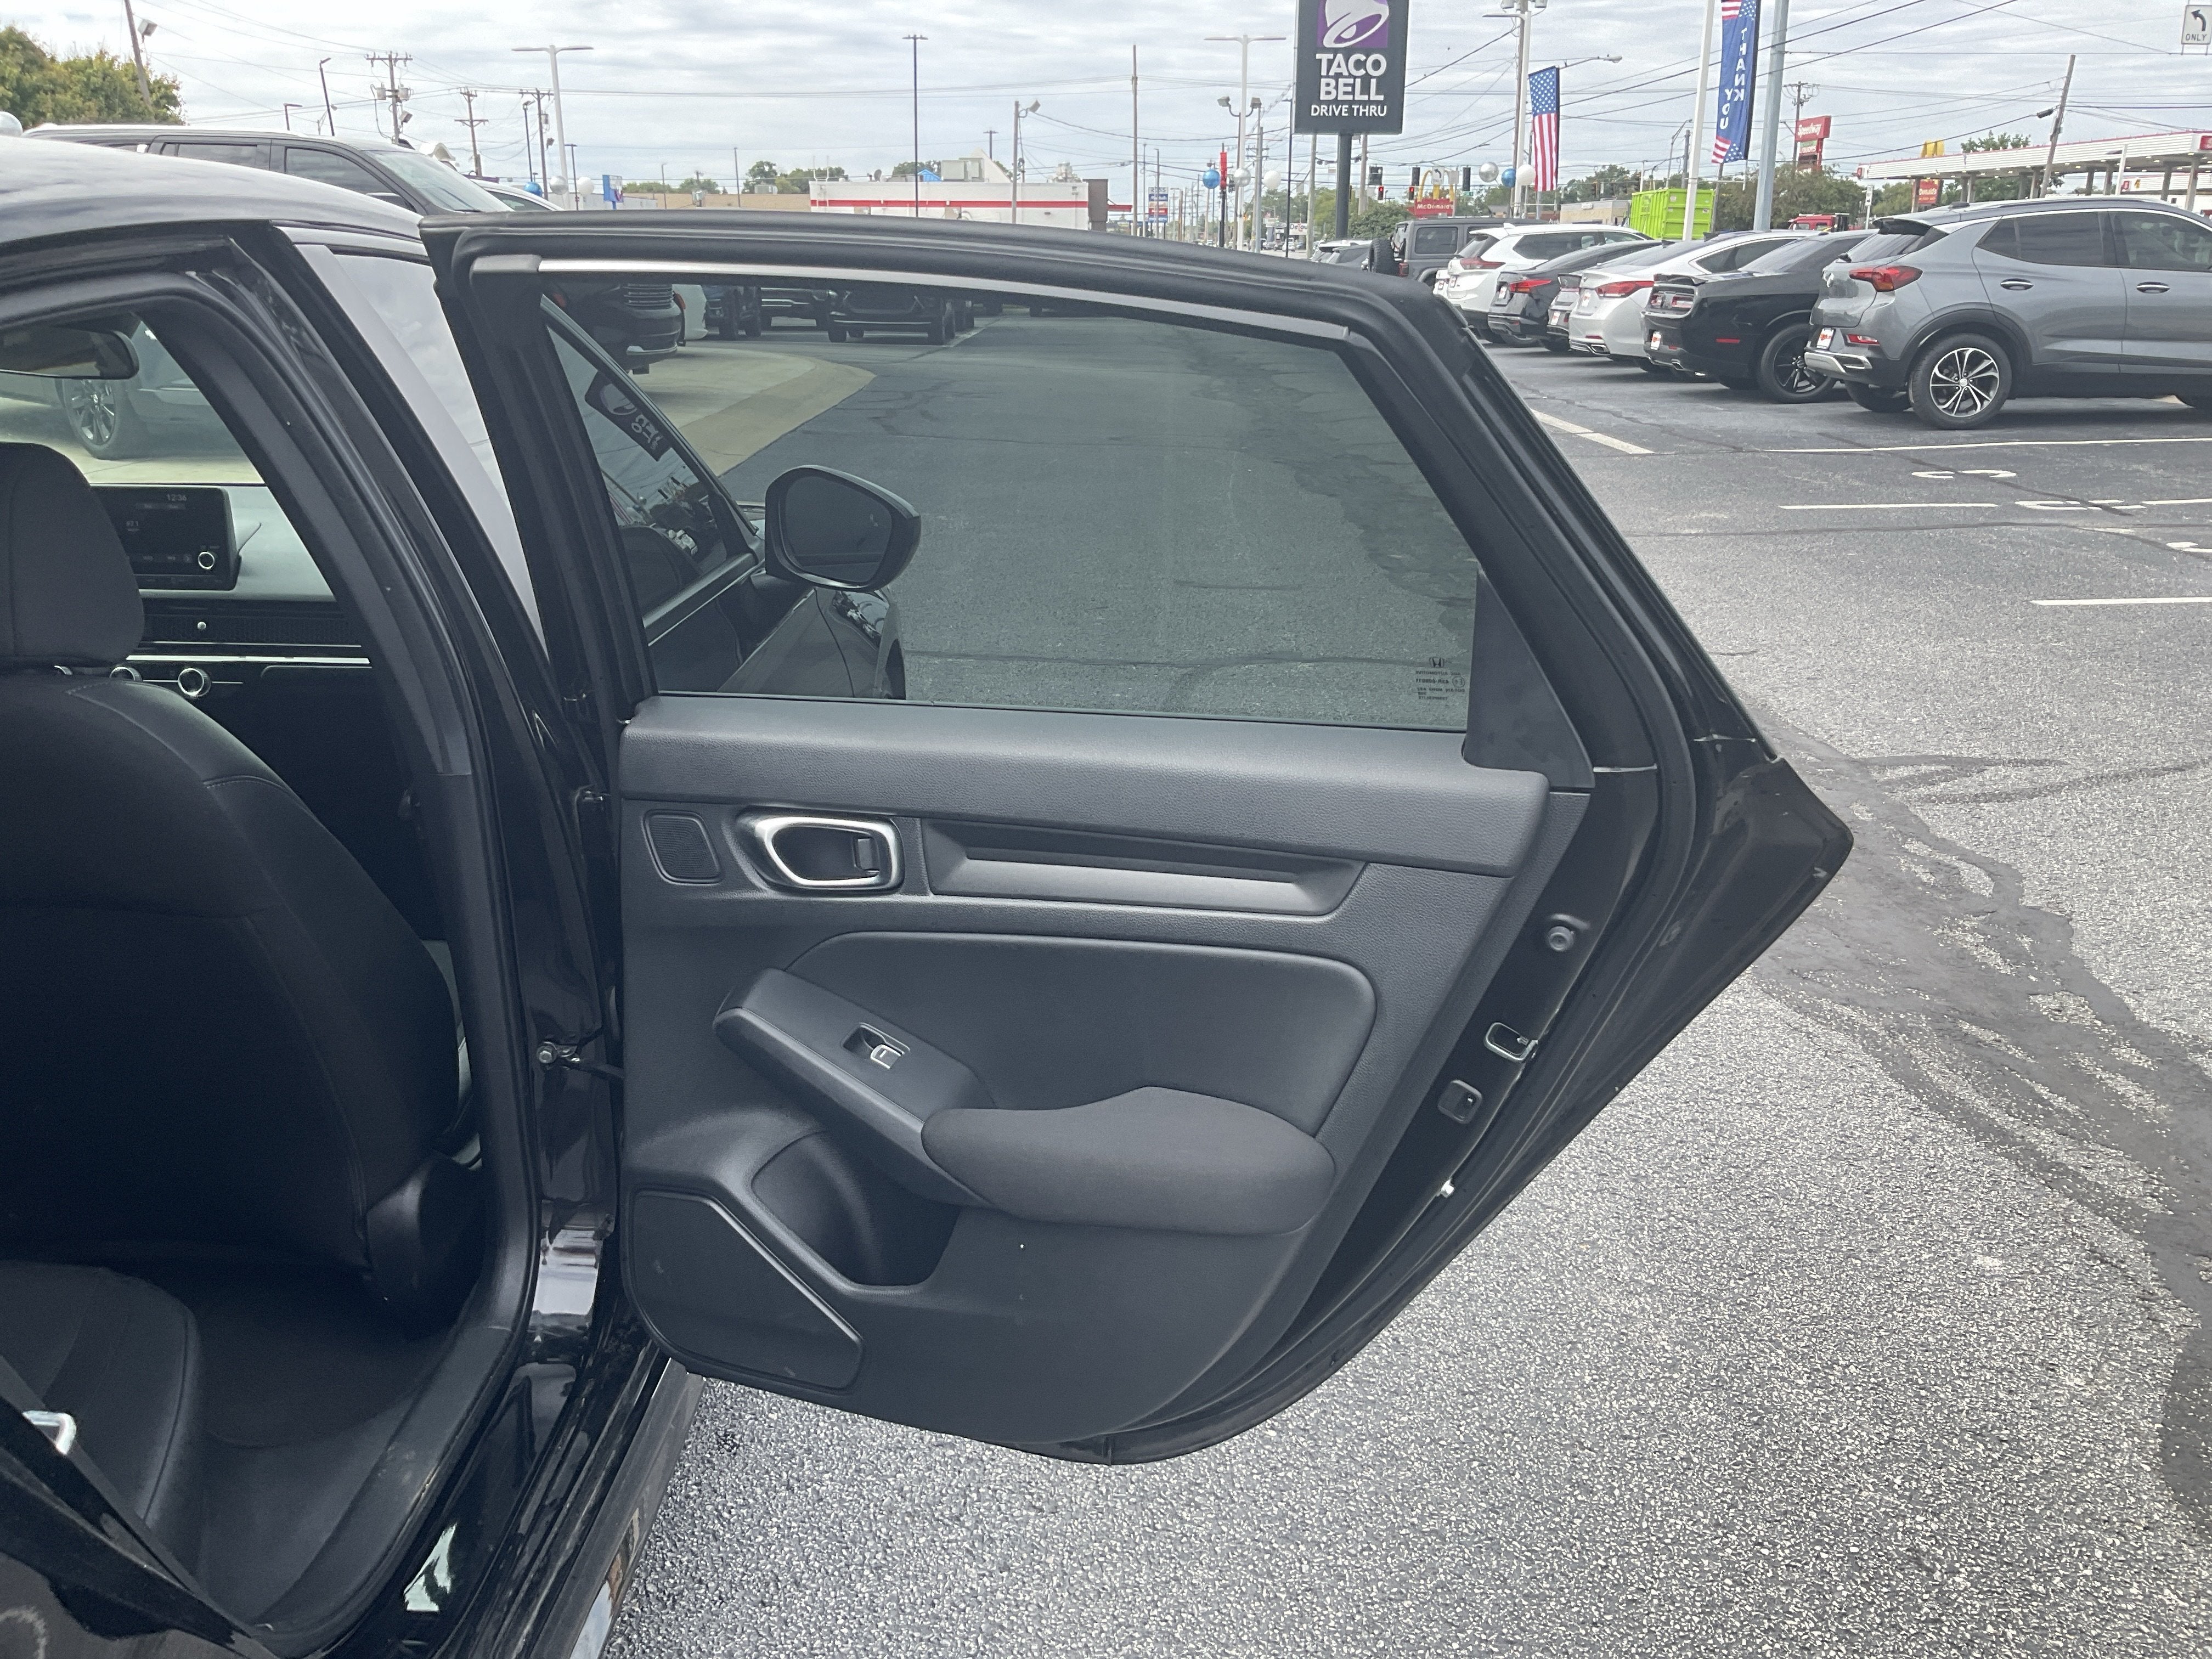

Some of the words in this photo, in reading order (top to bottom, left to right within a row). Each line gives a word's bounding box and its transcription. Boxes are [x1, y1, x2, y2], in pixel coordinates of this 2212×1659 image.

[1316, 53, 1387, 77] TACO
[1319, 78, 1384, 101] BELL
[1311, 105, 1348, 116] DRIVE
[1352, 105, 1387, 117] THRU
[1797, 122, 1822, 138] Speedway
